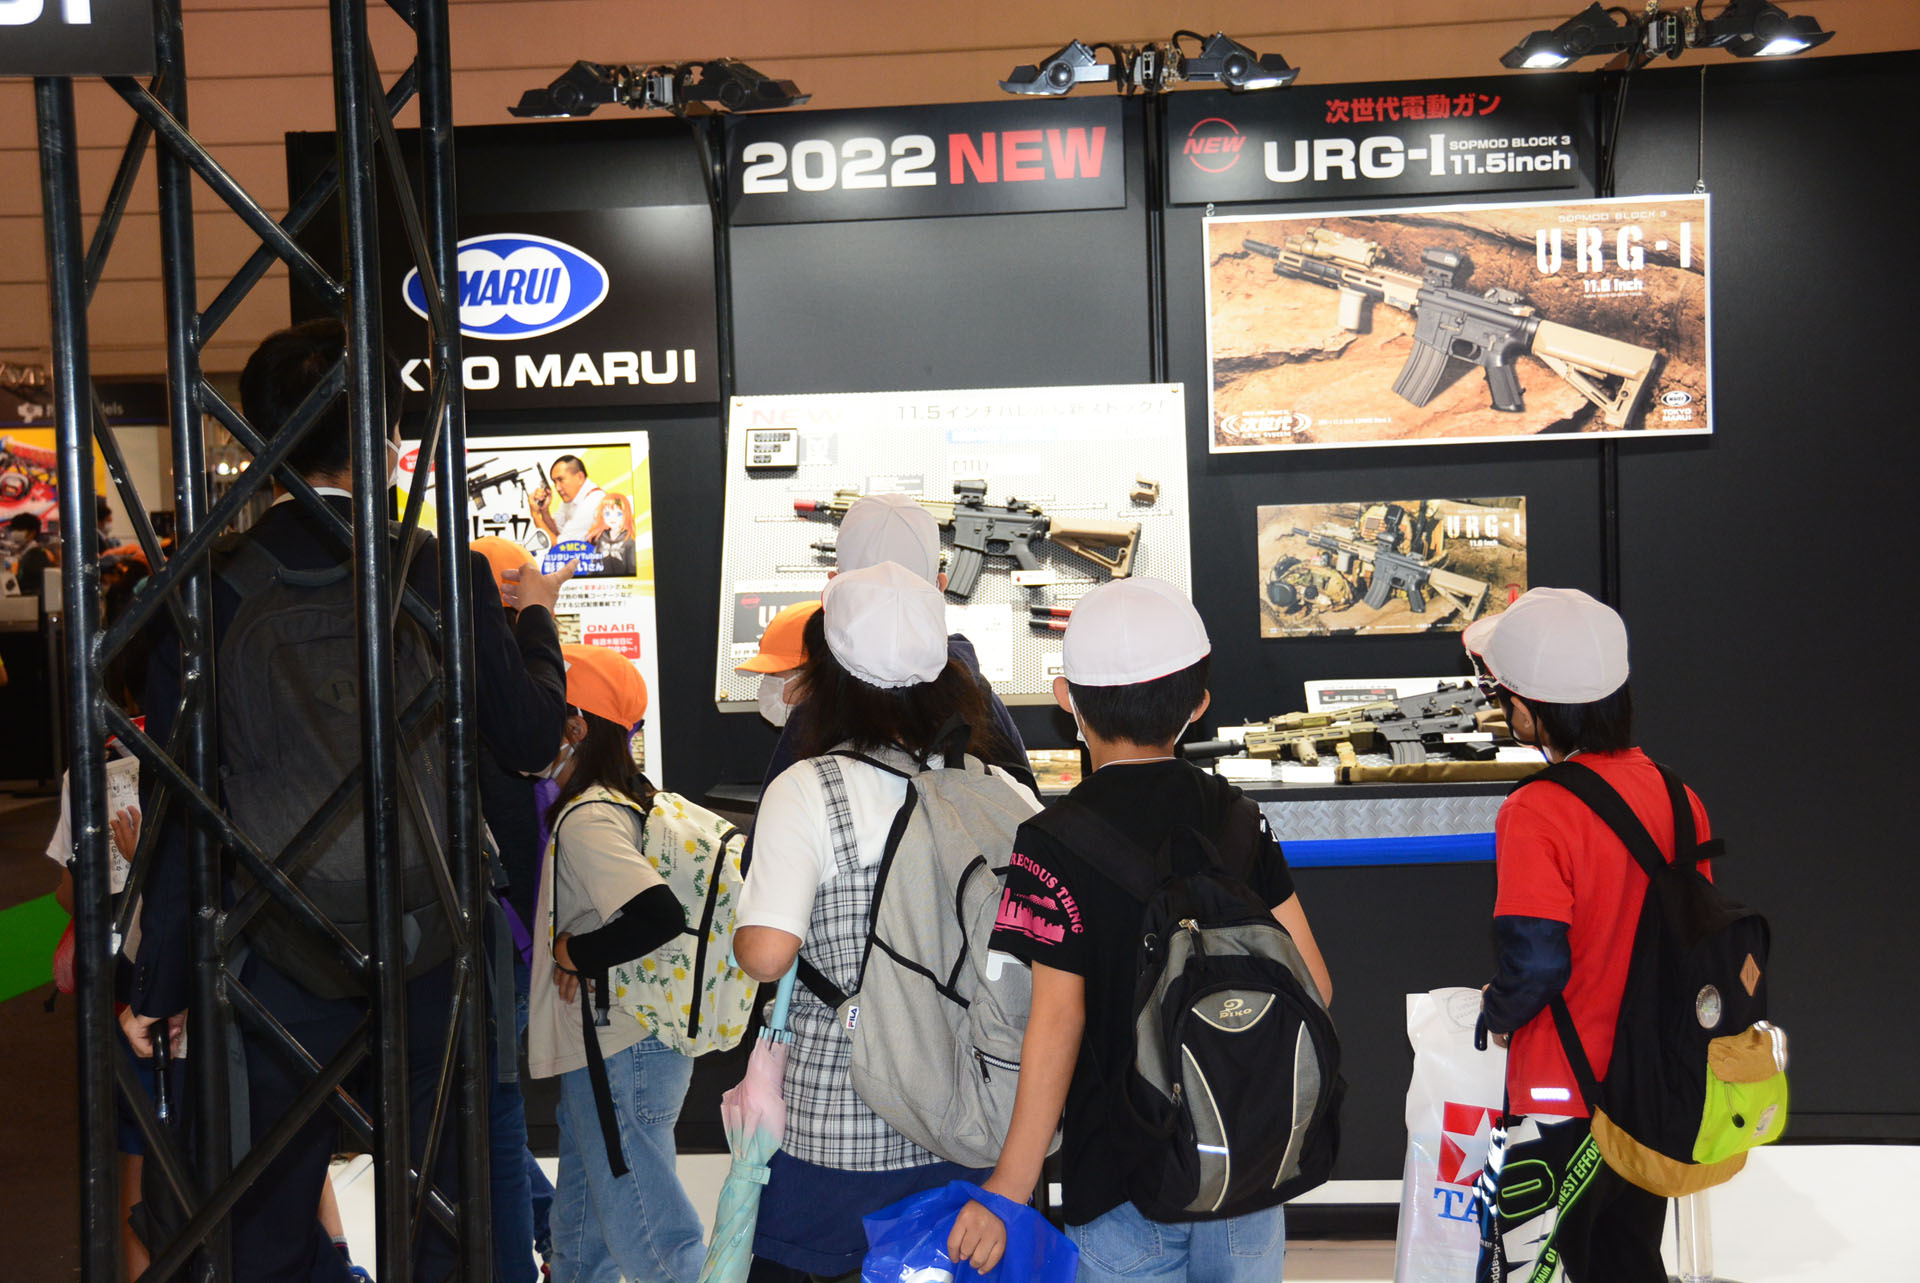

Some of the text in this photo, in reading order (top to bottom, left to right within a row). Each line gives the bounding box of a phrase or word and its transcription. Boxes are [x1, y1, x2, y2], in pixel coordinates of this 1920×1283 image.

[1325, 94, 1501, 125] 次世代電動ガン
[1183, 135, 1246, 154] NEW
[1449, 135, 1571, 151] SOPMOD BLOCK 3
[742, 126, 1107, 194] 2022 NEW
[1264, 134, 1446, 183] URG-I
[1449, 149, 1571, 175] 11.5inch
[1558, 213, 1609, 223] SOPMOD
[1615, 210, 1656, 220] BLOCK
[458, 267, 562, 307] MARUI
[1613, 278, 1643, 292] inch
[515, 349, 697, 389] MARUI
[1447, 513, 1521, 539] URG-I
[567, 543, 580, 551] MC
[587, 623, 636, 632] ON AIR
[1056, 886, 1084, 934] THING
[848, 1008, 858, 1028] FILA
